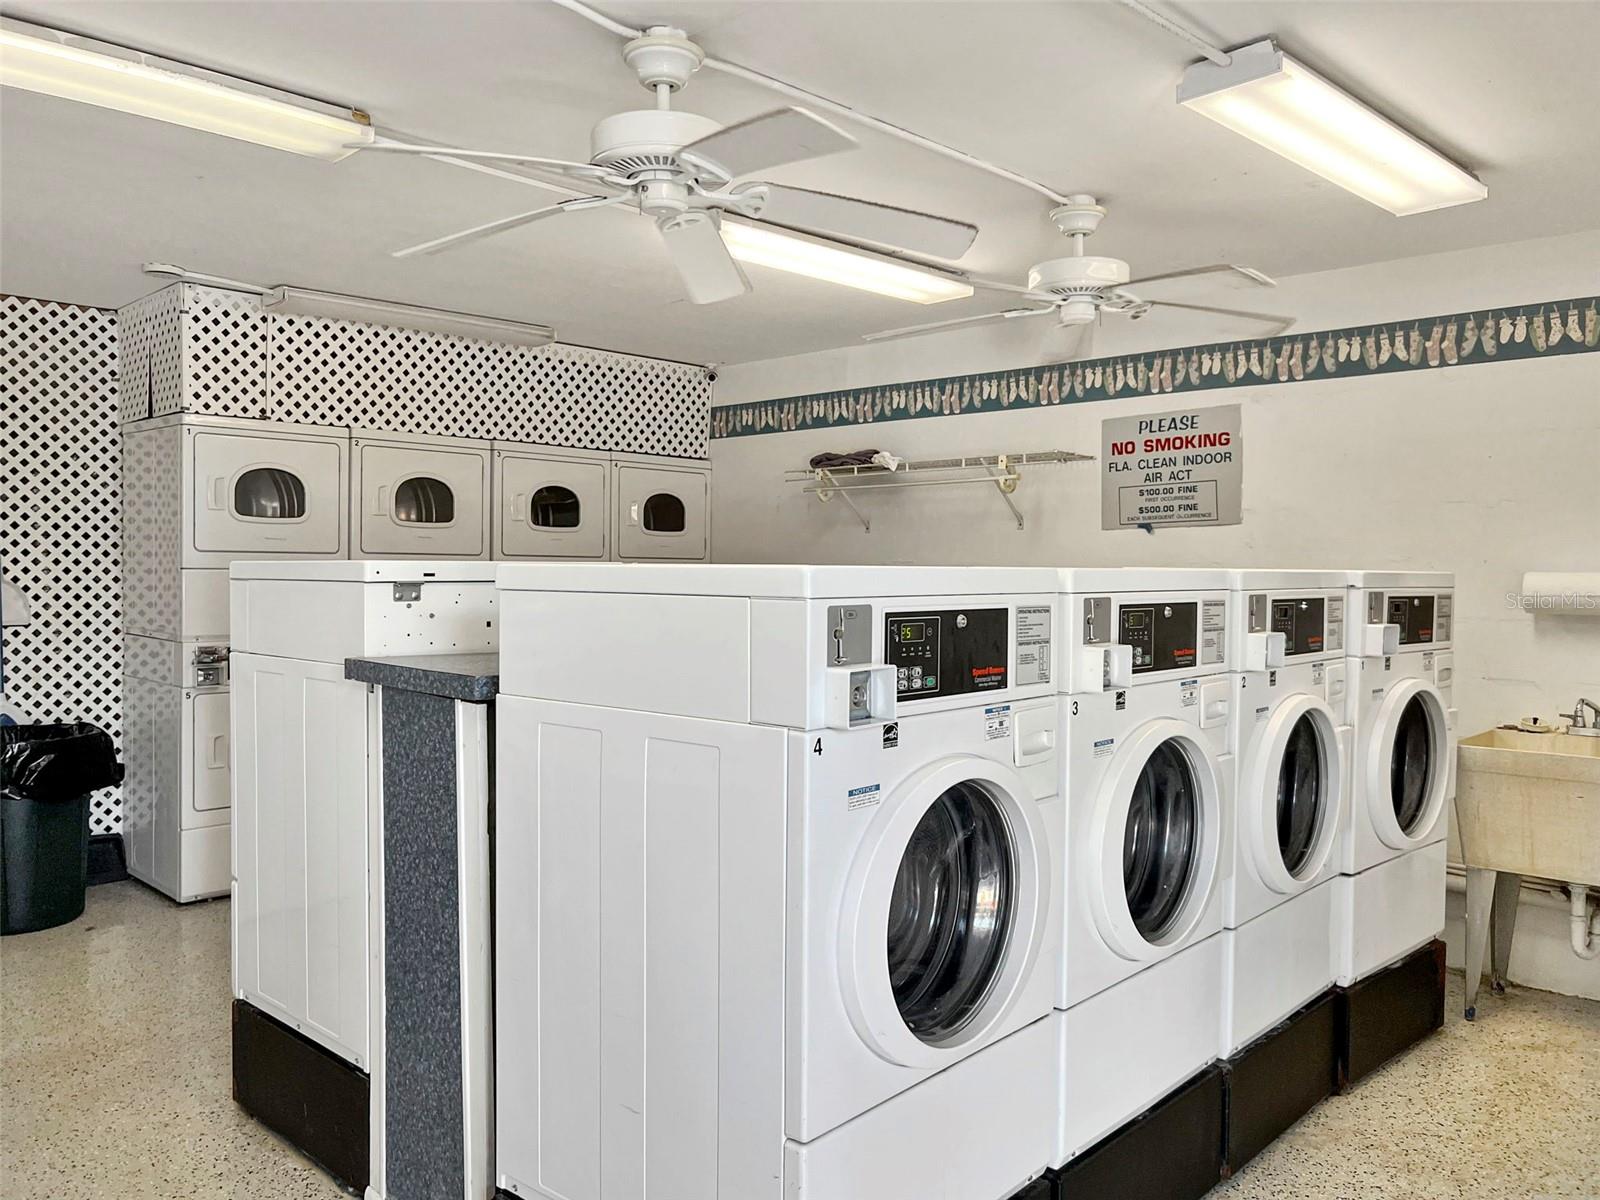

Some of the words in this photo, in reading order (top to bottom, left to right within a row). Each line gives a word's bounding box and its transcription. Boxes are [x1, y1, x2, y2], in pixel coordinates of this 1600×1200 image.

[1138, 415, 1200, 434] PLEASE
[1111, 441, 1136, 456] NO
[1143, 432, 1231, 453] SMOKING
[1108, 461, 1132, 473] FLA.
[1137, 456, 1177, 470] CLEAN
[1183, 451, 1232, 466] INDOOR
[1144, 472, 1163, 483] AIR
[1168, 469, 1192, 481] ACT
[1138, 487, 1174, 497] $100.00
[1177, 485, 1199, 494] FINE
[1138, 505, 1175, 514] $500.00
[1178, 503, 1199, 512] FINE
[1241, 676, 1246, 688] 2
[185, 692, 191, 700] 5
[1072, 701, 1079, 716] 3
[813, 737, 823, 756] 4
